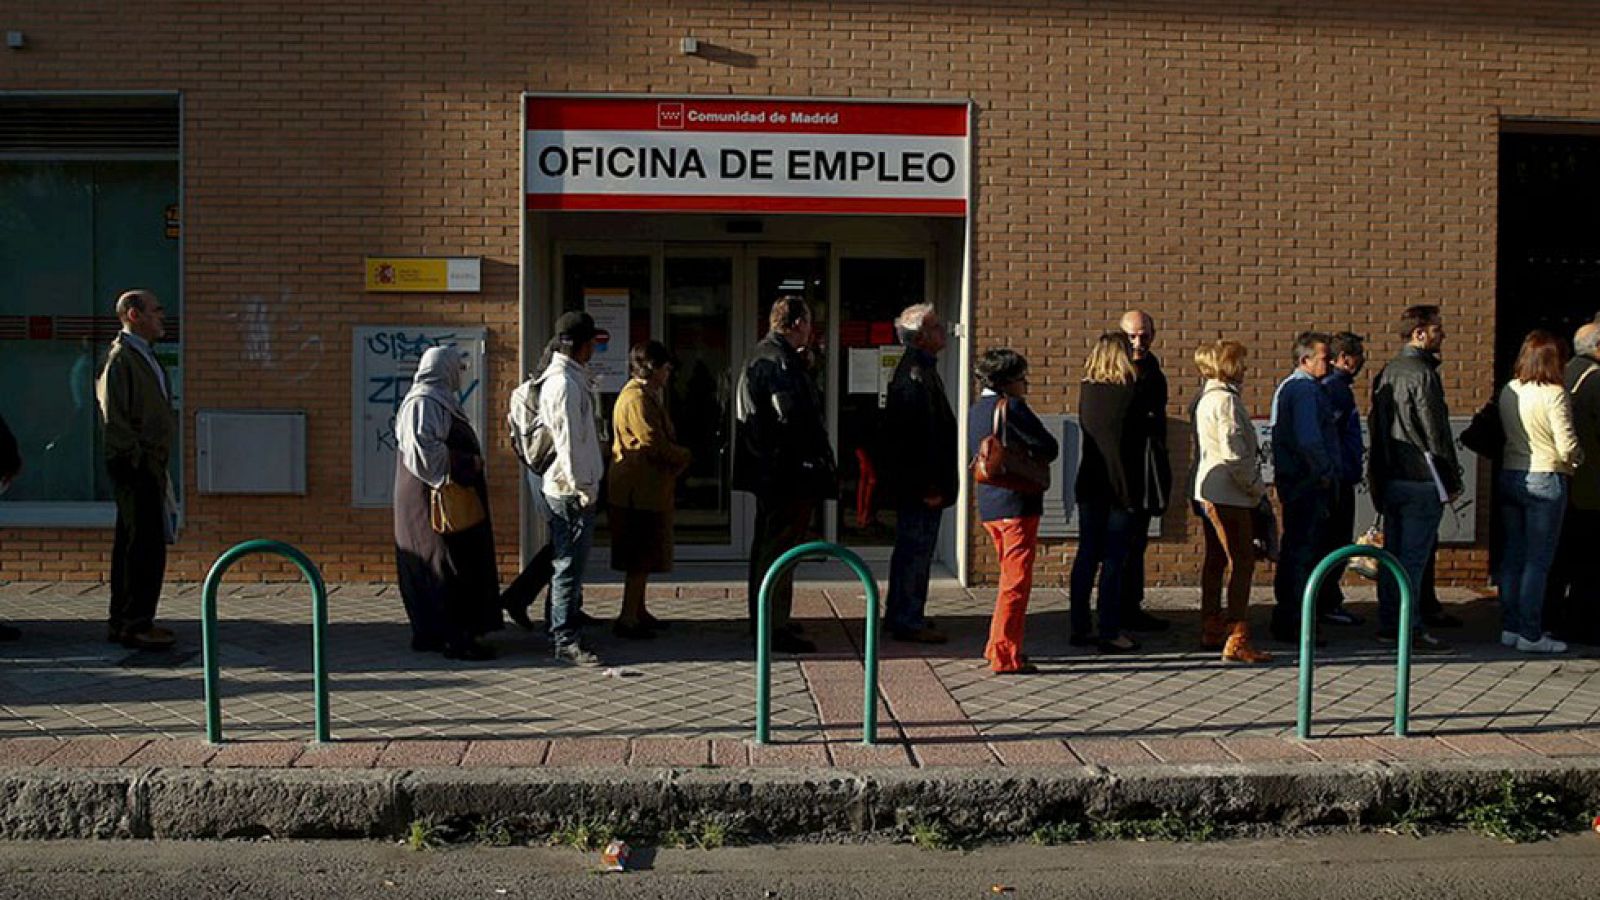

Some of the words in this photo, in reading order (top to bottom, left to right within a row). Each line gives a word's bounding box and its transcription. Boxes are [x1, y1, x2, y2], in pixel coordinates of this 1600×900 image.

[687, 110, 765, 123] Comunidad
[768, 111, 787, 124] de
[791, 112, 839, 125] Madrid
[538, 146, 706, 179] OFICINA
[719, 149, 774, 180] DE
[787, 150, 957, 184] EMPLEO
